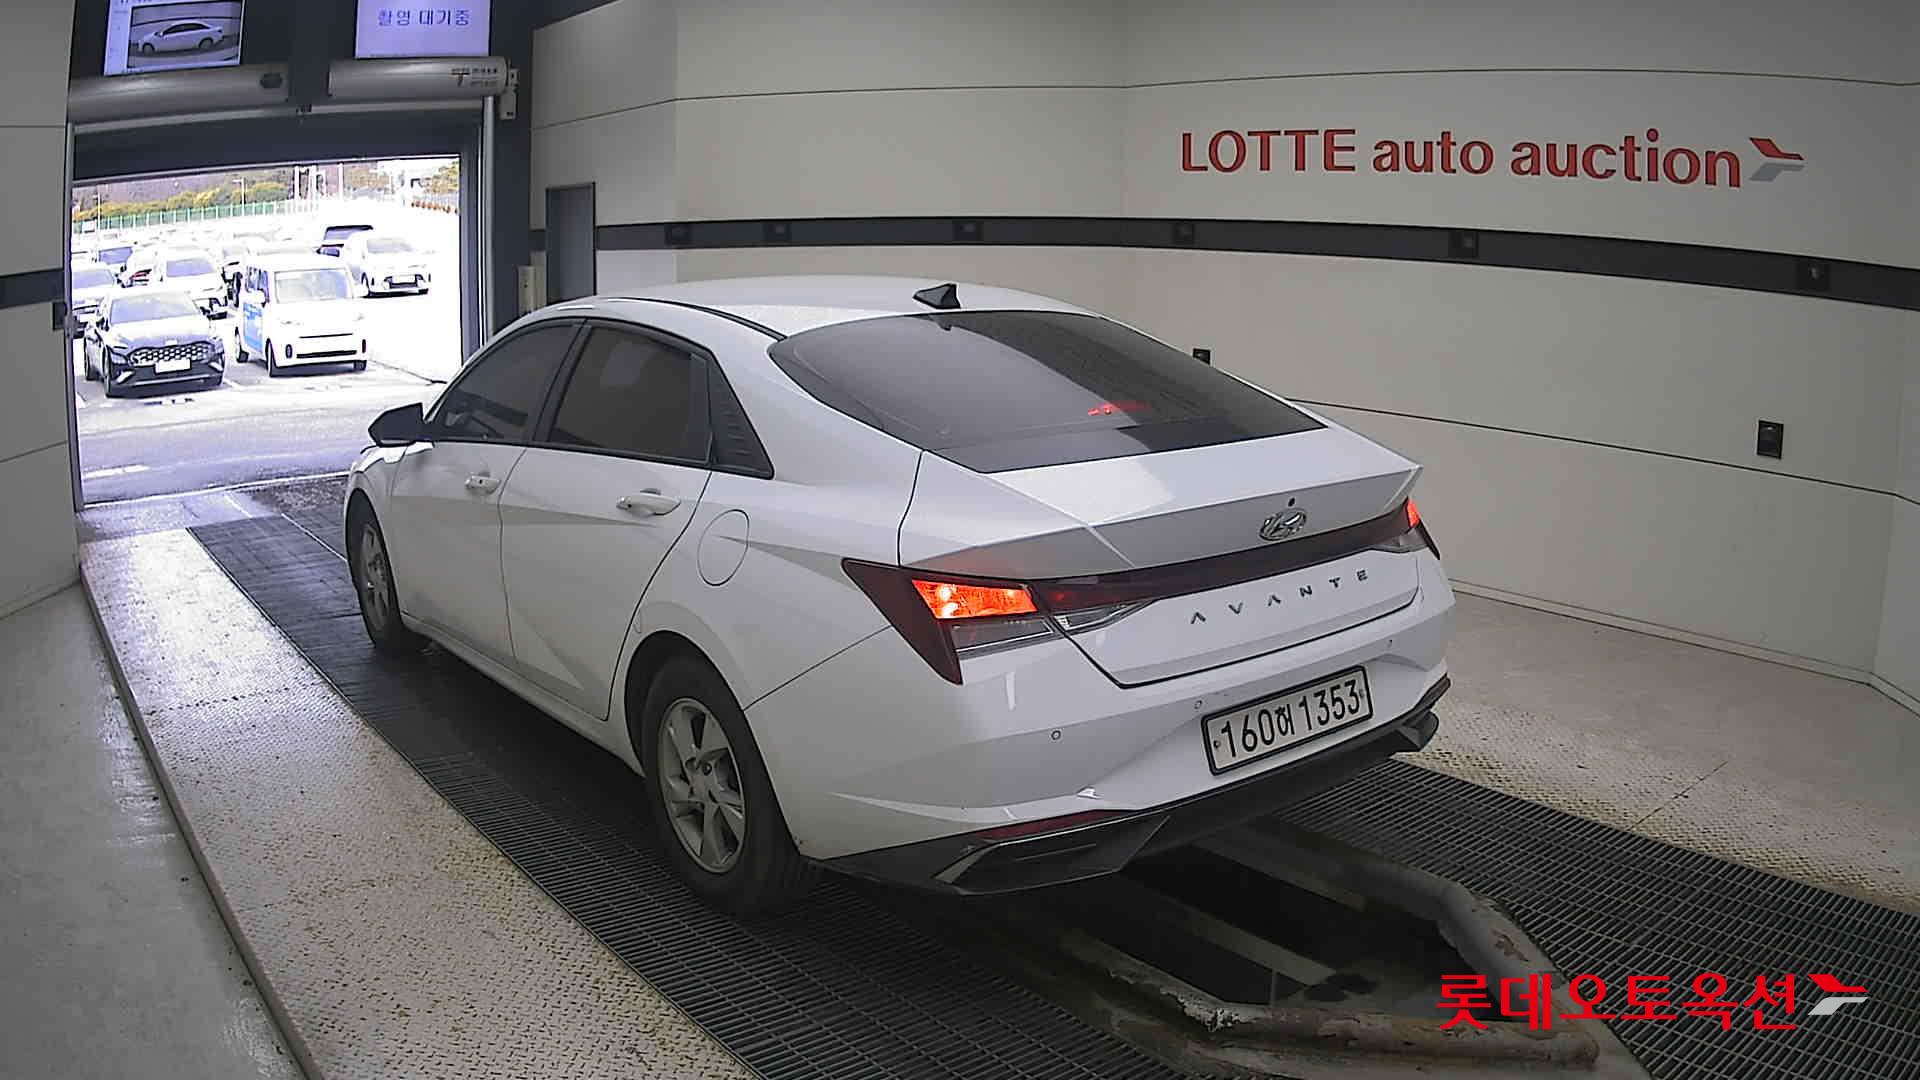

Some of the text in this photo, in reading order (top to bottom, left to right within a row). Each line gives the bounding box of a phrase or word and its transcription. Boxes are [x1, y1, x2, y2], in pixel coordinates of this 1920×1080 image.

[419, 9, 470, 26] 대기중
[1181, 128, 1741, 187] LOTTE auto auction
[1190, 569, 1368, 625] AVANTE
[1221, 679, 1360, 758] 160허 1353
